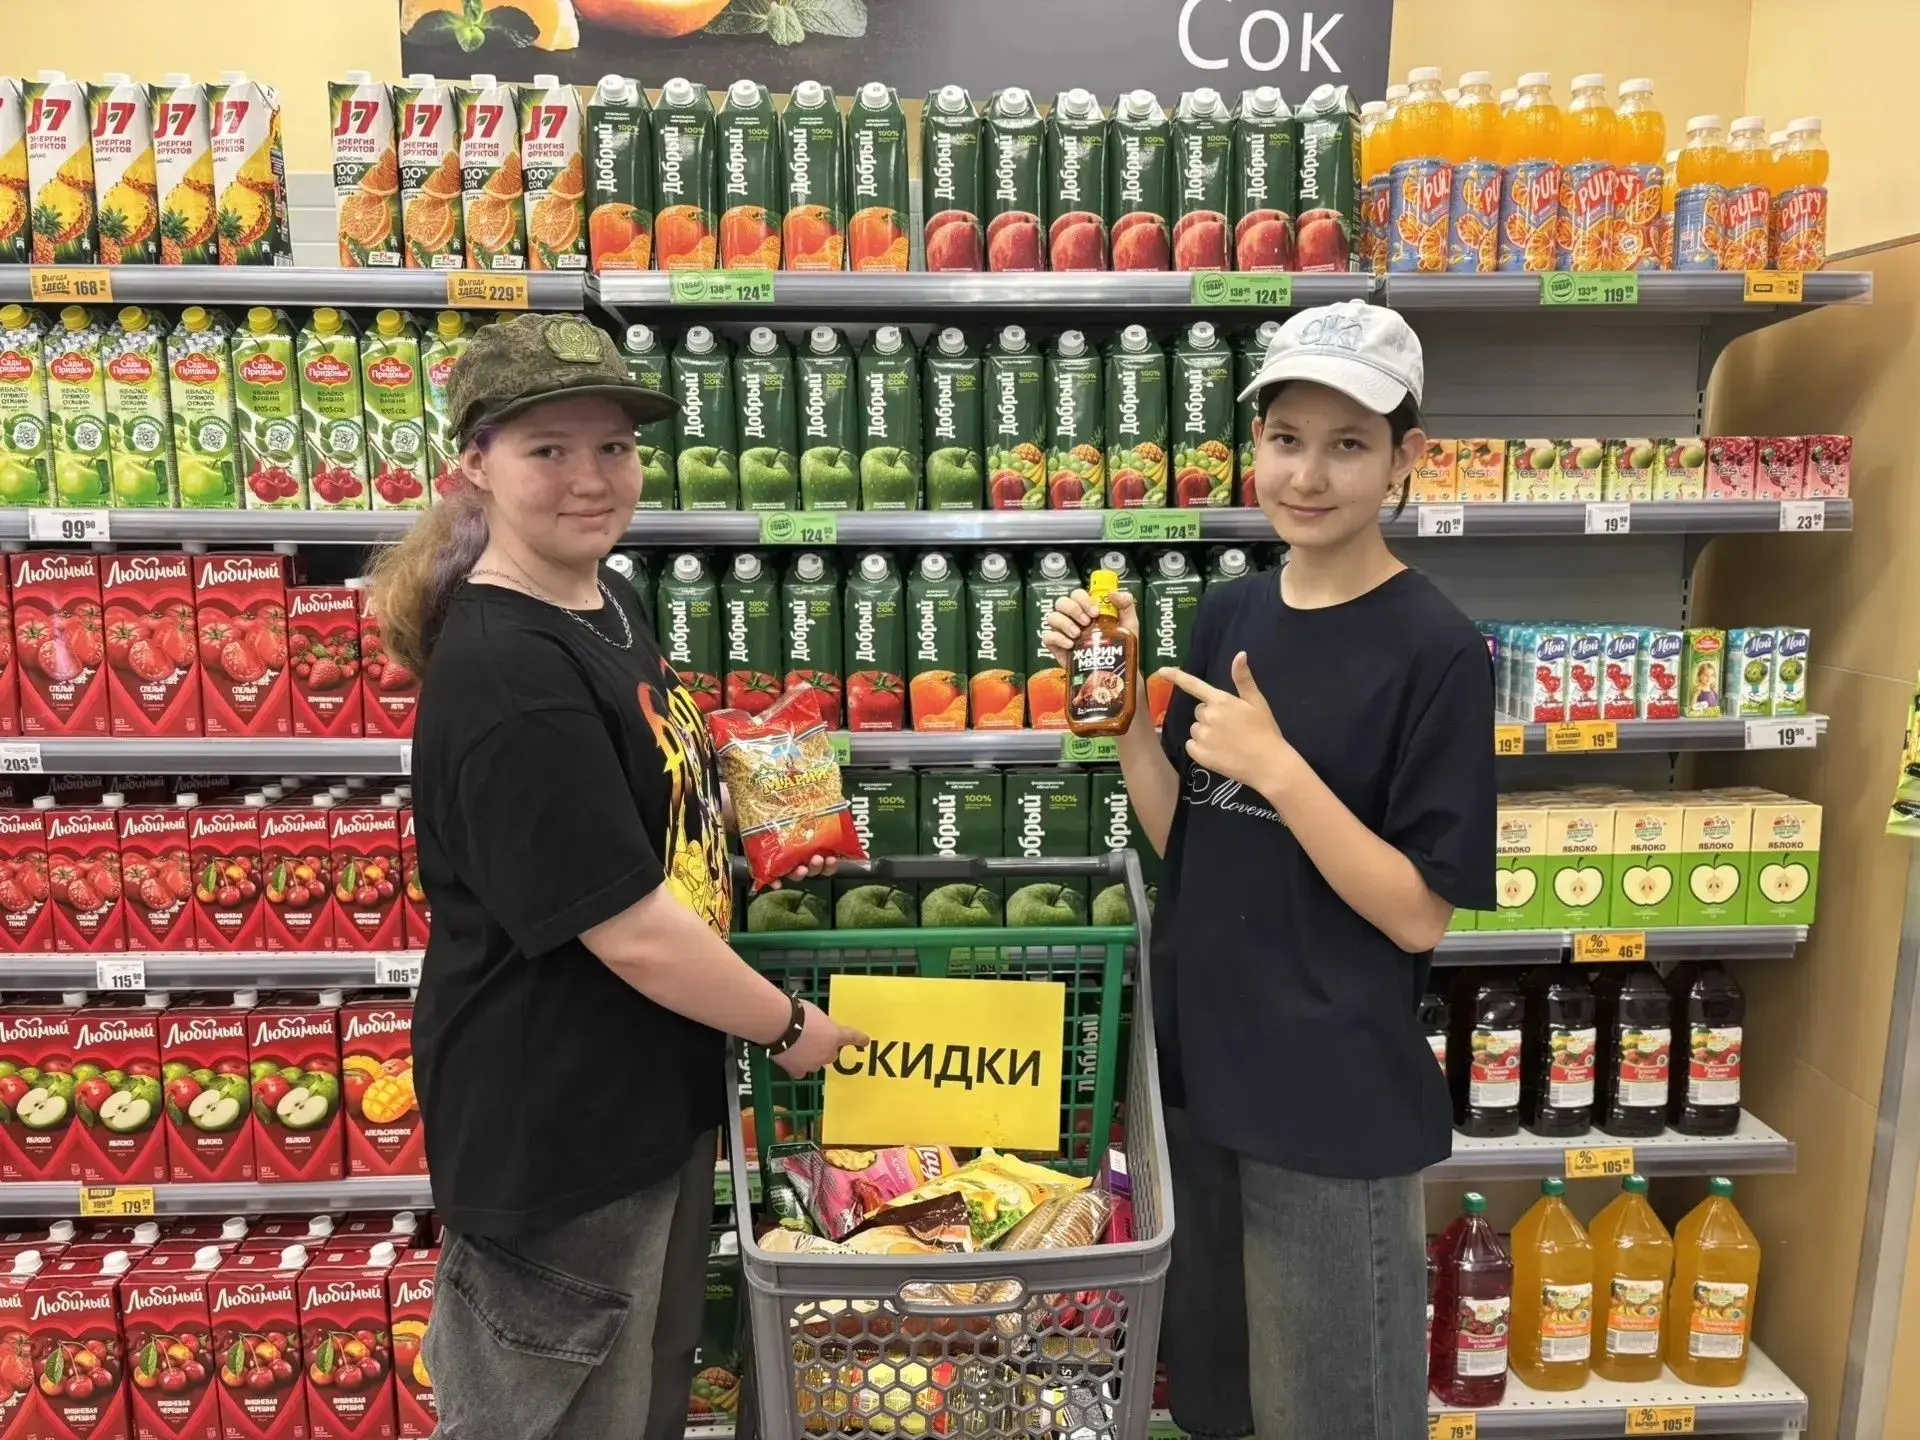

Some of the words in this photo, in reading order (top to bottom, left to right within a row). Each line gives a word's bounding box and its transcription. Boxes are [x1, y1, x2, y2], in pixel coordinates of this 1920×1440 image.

[1178, 0, 1344, 73] Сок
[28, 98, 72, 133] J7
[93, 102, 135, 137] J7
[154, 104, 196, 138] J7
[211, 101, 249, 137] J7
[335, 101, 379, 136] J7
[402, 104, 442, 140] J7
[464, 105, 503, 141] J7
[525, 106, 568, 141] J7
[337, 164, 363, 175] 100%
[597, 122, 617, 192] Добрый
[663, 126, 684, 195] Добрый
[728, 129, 748, 195] Добрый
[789, 127, 811, 195] Добрый
[855, 130, 877, 196] Добрый
[933, 131, 955, 200] Добрый
[995, 134, 1016, 201] Добрый
[1059, 135, 1080, 201] Добрый
[1122, 136, 1143, 202] Добрый
[1184, 134, 1205, 201] Добрый
[1246, 133, 1267, 199] Добрый
[1300, 134, 1319, 200] Добрый
[403, 168, 428, 178] 100%
[464, 168, 489, 179] 100%
[528, 169, 554, 179] 100%
[1782, 192, 1821, 228] PULPY
[73, 281, 98, 295] 168
[489, 286, 514, 301] 229
[737, 286, 759, 300] 124
[1255, 290, 1277, 304] 124
[1604, 288, 1623, 302] 119
[680, 372, 704, 437] Добрый
[742, 373, 765, 438] Добрый
[804, 374, 827, 438] Добрый
[866, 372, 888, 438] Добрый
[934, 374, 955, 439] Добрый
[997, 369, 1019, 436] Добрый
[1054, 374, 1077, 436] Добрый
[1118, 369, 1141, 435] Добрый
[1184, 370, 1206, 433] Добрый
[62, 520, 85, 539] 99
[800, 528, 822, 542] 124
[1165, 526, 1186, 538] 124
[1436, 520, 1451, 534] 20
[1605, 518, 1618, 532] 19
[1797, 516, 1812, 529] 23
[13, 556, 96, 588] Любимый
[104, 557, 188, 588] Любимый
[197, 558, 281, 588] Любимый
[289, 593, 354, 617] Любимый
[668, 600, 691, 662] Добрый
[727, 600, 749, 662] Добрый
[788, 599, 810, 661] Добрый
[854, 600, 876, 662] Добрый
[916, 599, 938, 661] Добрый
[976, 599, 998, 660] Добрый
[1155, 597, 1177, 658] Добрый
[1073, 646, 1122, 660] ЖАРИМ
[1078, 656, 1115, 668] МЯСО
[1777, 728, 1795, 746] 19
[4, 759, 29, 771] 203
[878, 796, 905, 804] 100%
[965, 794, 992, 802] 100%
[47, 814, 114, 840] Любимый
[121, 814, 186, 839] Любимый
[191, 814, 257, 839] Любимый
[260, 814, 327, 839] Любимый
[331, 814, 396, 839] Любимый
[1631, 844, 1666, 852] ЯБЛОКО
[1619, 946, 1633, 957] 46
[112, 975, 132, 987] 115
[388, 969, 409, 982] 105
[73, 1020, 156, 1049] Любимый
[163, 1018, 244, 1048] Любимый
[252, 1017, 334, 1047] Любимый
[343, 1011, 412, 1041] Любимы
[833, 1039, 1041, 1090] СКИДКИ
[919, 1147, 941, 1179] Lay
[1603, 1161, 1621, 1173] 105
[122, 1201, 141, 1213] 179
[31, 1290, 111, 1321] Любимый
[124, 1285, 204, 1313] Любимый
[213, 1284, 293, 1313] Любимый
[302, 1282, 382, 1311] Любимый
[1450, 1427, 1464, 1439] 79
[1662, 1419, 1683, 1431] 105
